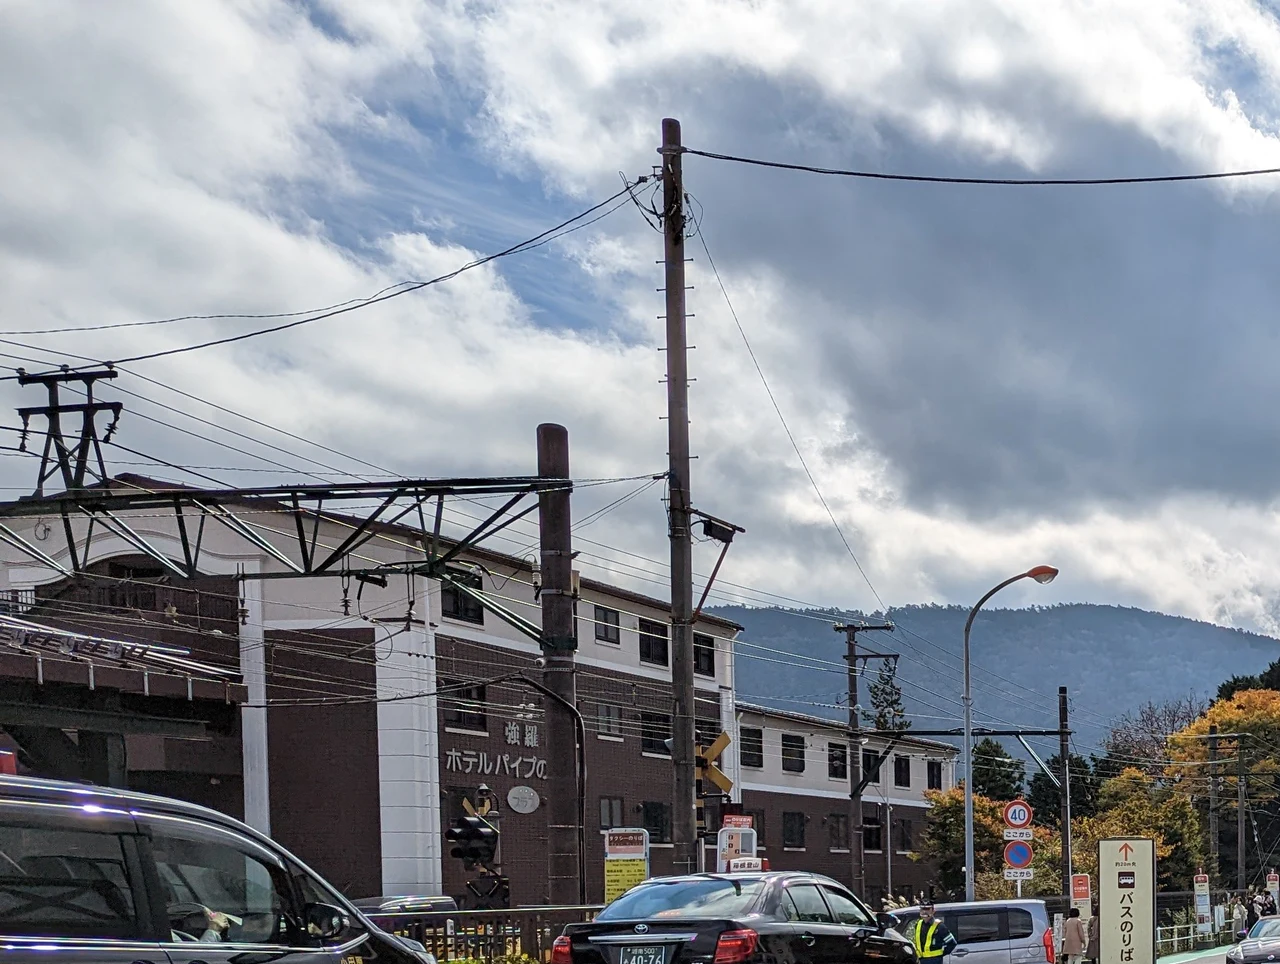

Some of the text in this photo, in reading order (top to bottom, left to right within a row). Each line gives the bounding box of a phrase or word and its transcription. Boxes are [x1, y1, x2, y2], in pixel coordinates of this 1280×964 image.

[505, 721, 538, 748] 強羅
[1010, 808, 1026, 821] 40
[1120, 891, 1134, 962] バスのりば
